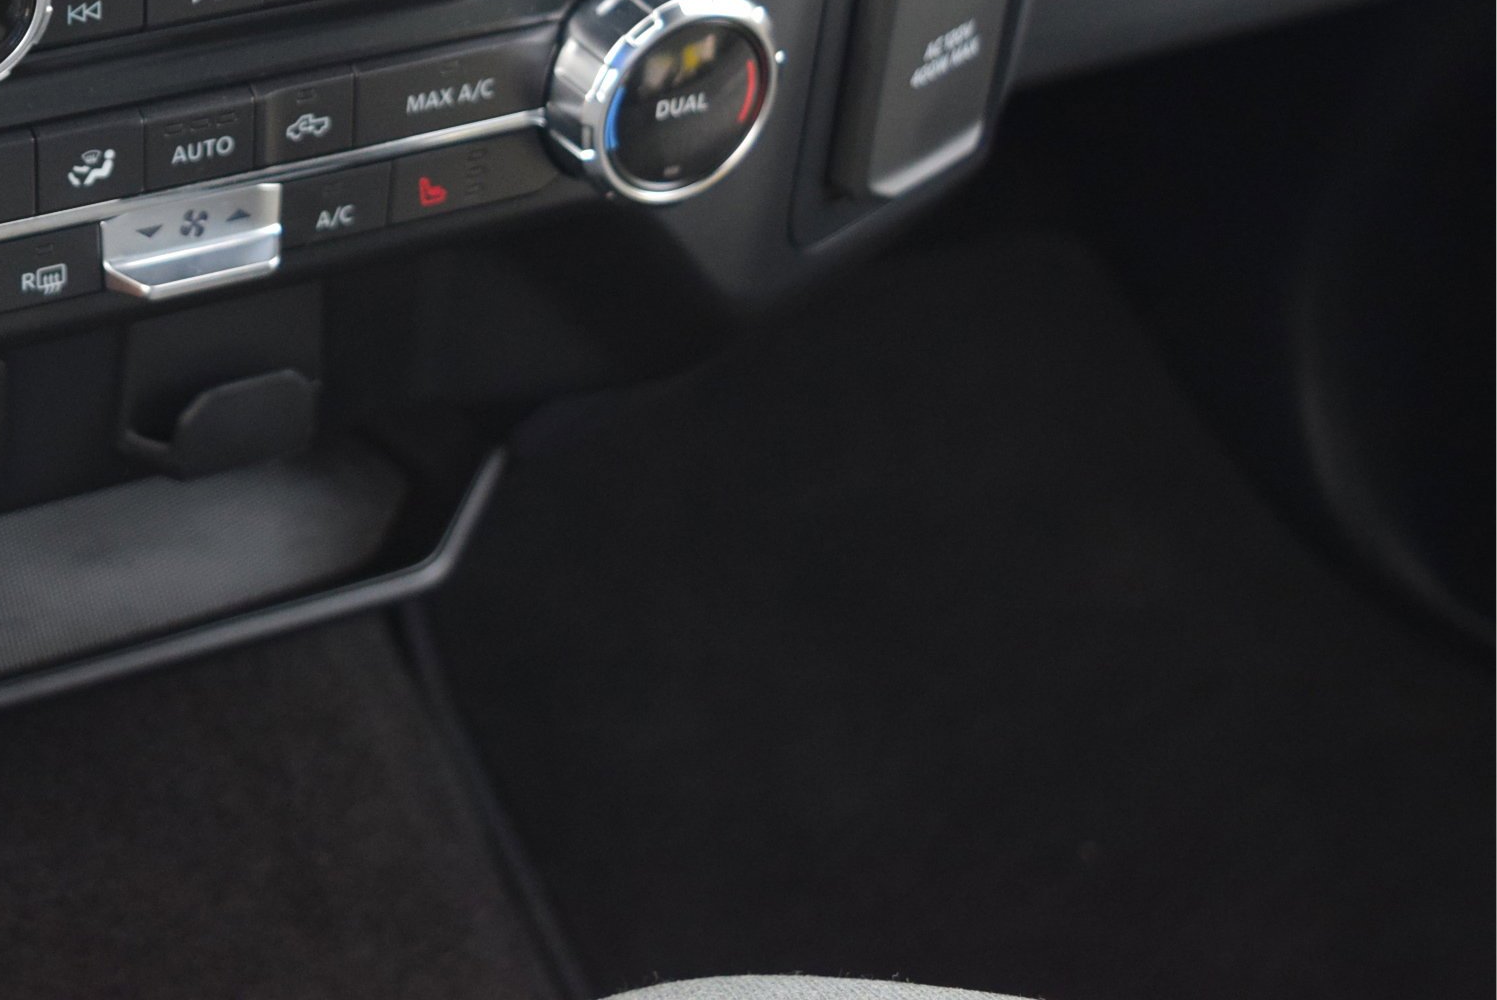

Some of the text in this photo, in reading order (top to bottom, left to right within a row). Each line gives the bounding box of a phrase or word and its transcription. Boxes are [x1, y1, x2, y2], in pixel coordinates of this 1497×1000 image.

[406, 78, 493, 113] MAX A/C
[655, 93, 708, 119] DUAL
[171, 135, 235, 164] AUTO
[316, 204, 353, 229] A/C
[21, 272, 36, 291] R
